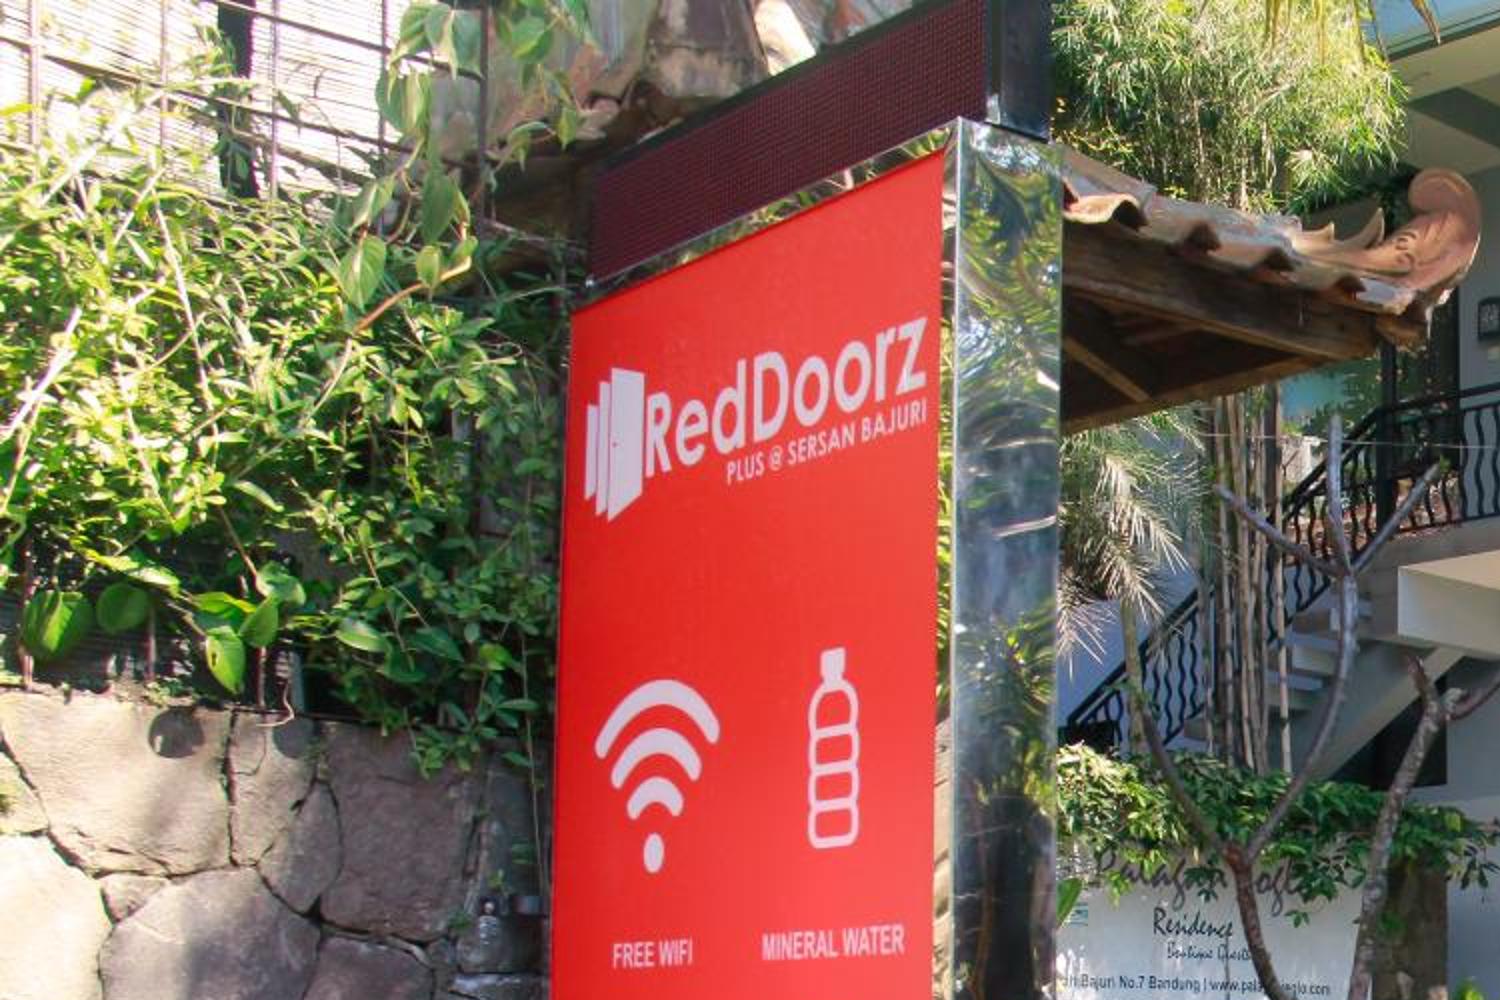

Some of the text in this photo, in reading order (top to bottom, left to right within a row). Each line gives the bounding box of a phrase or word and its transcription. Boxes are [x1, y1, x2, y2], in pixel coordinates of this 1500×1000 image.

[645, 317, 928, 478] RedDoorz
[726, 398, 928, 486] PLUS @ SERSAN BAJURI
[1153, 907, 1233, 938] Residence
[612, 937, 693, 969] FREE WIFI
[762, 923, 905, 961] MINERAL WATER
[1081, 973, 1117, 991] Bajuri
[1119, 975, 1145, 989] No.7
[1148, 975, 1201, 993] Bandung
